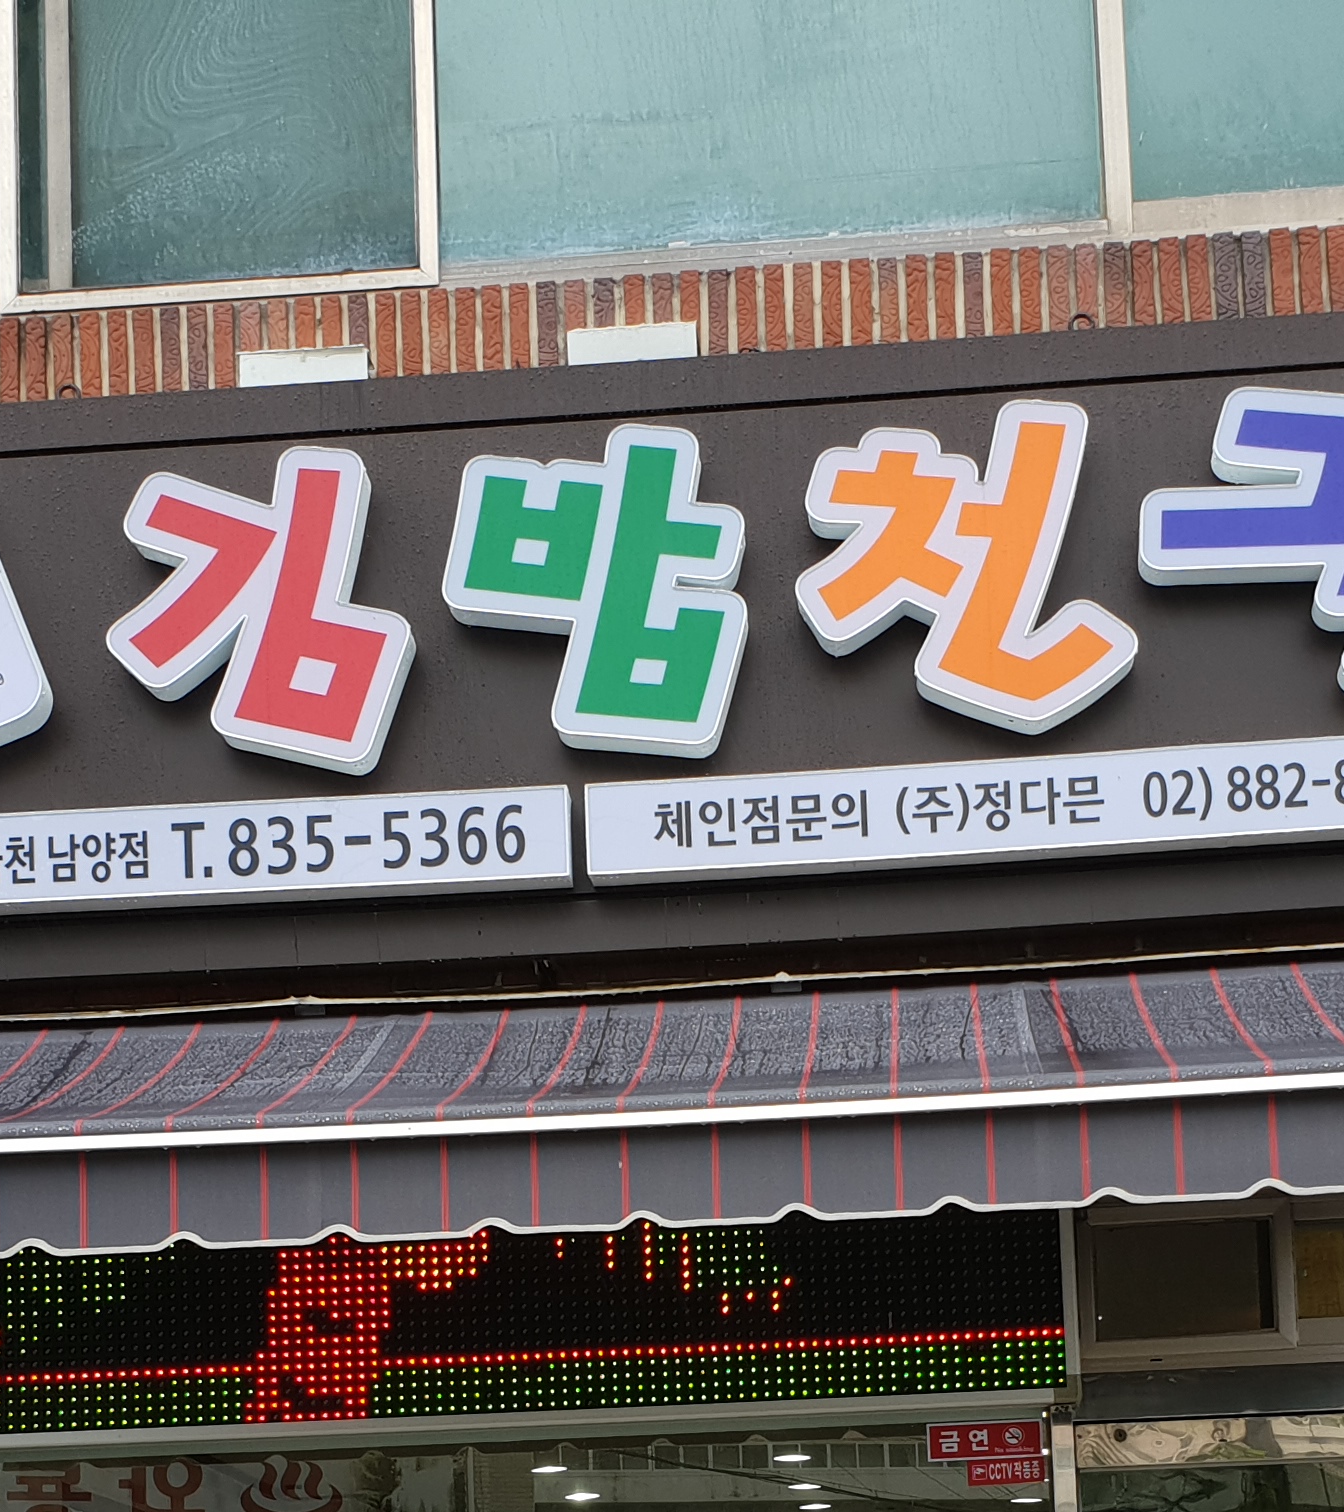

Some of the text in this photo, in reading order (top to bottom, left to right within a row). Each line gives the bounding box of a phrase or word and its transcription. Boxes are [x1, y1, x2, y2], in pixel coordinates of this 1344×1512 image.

[47, 828, 150, 883] 남양점
[170, 804, 526, 880] T.835-5366
[653, 786, 870, 851] 체인점문의
[896, 776, 1104, 835] (주)정다믄
[1143, 766, 1213, 824] 02)
[938, 1428, 990, 1454] 금연
